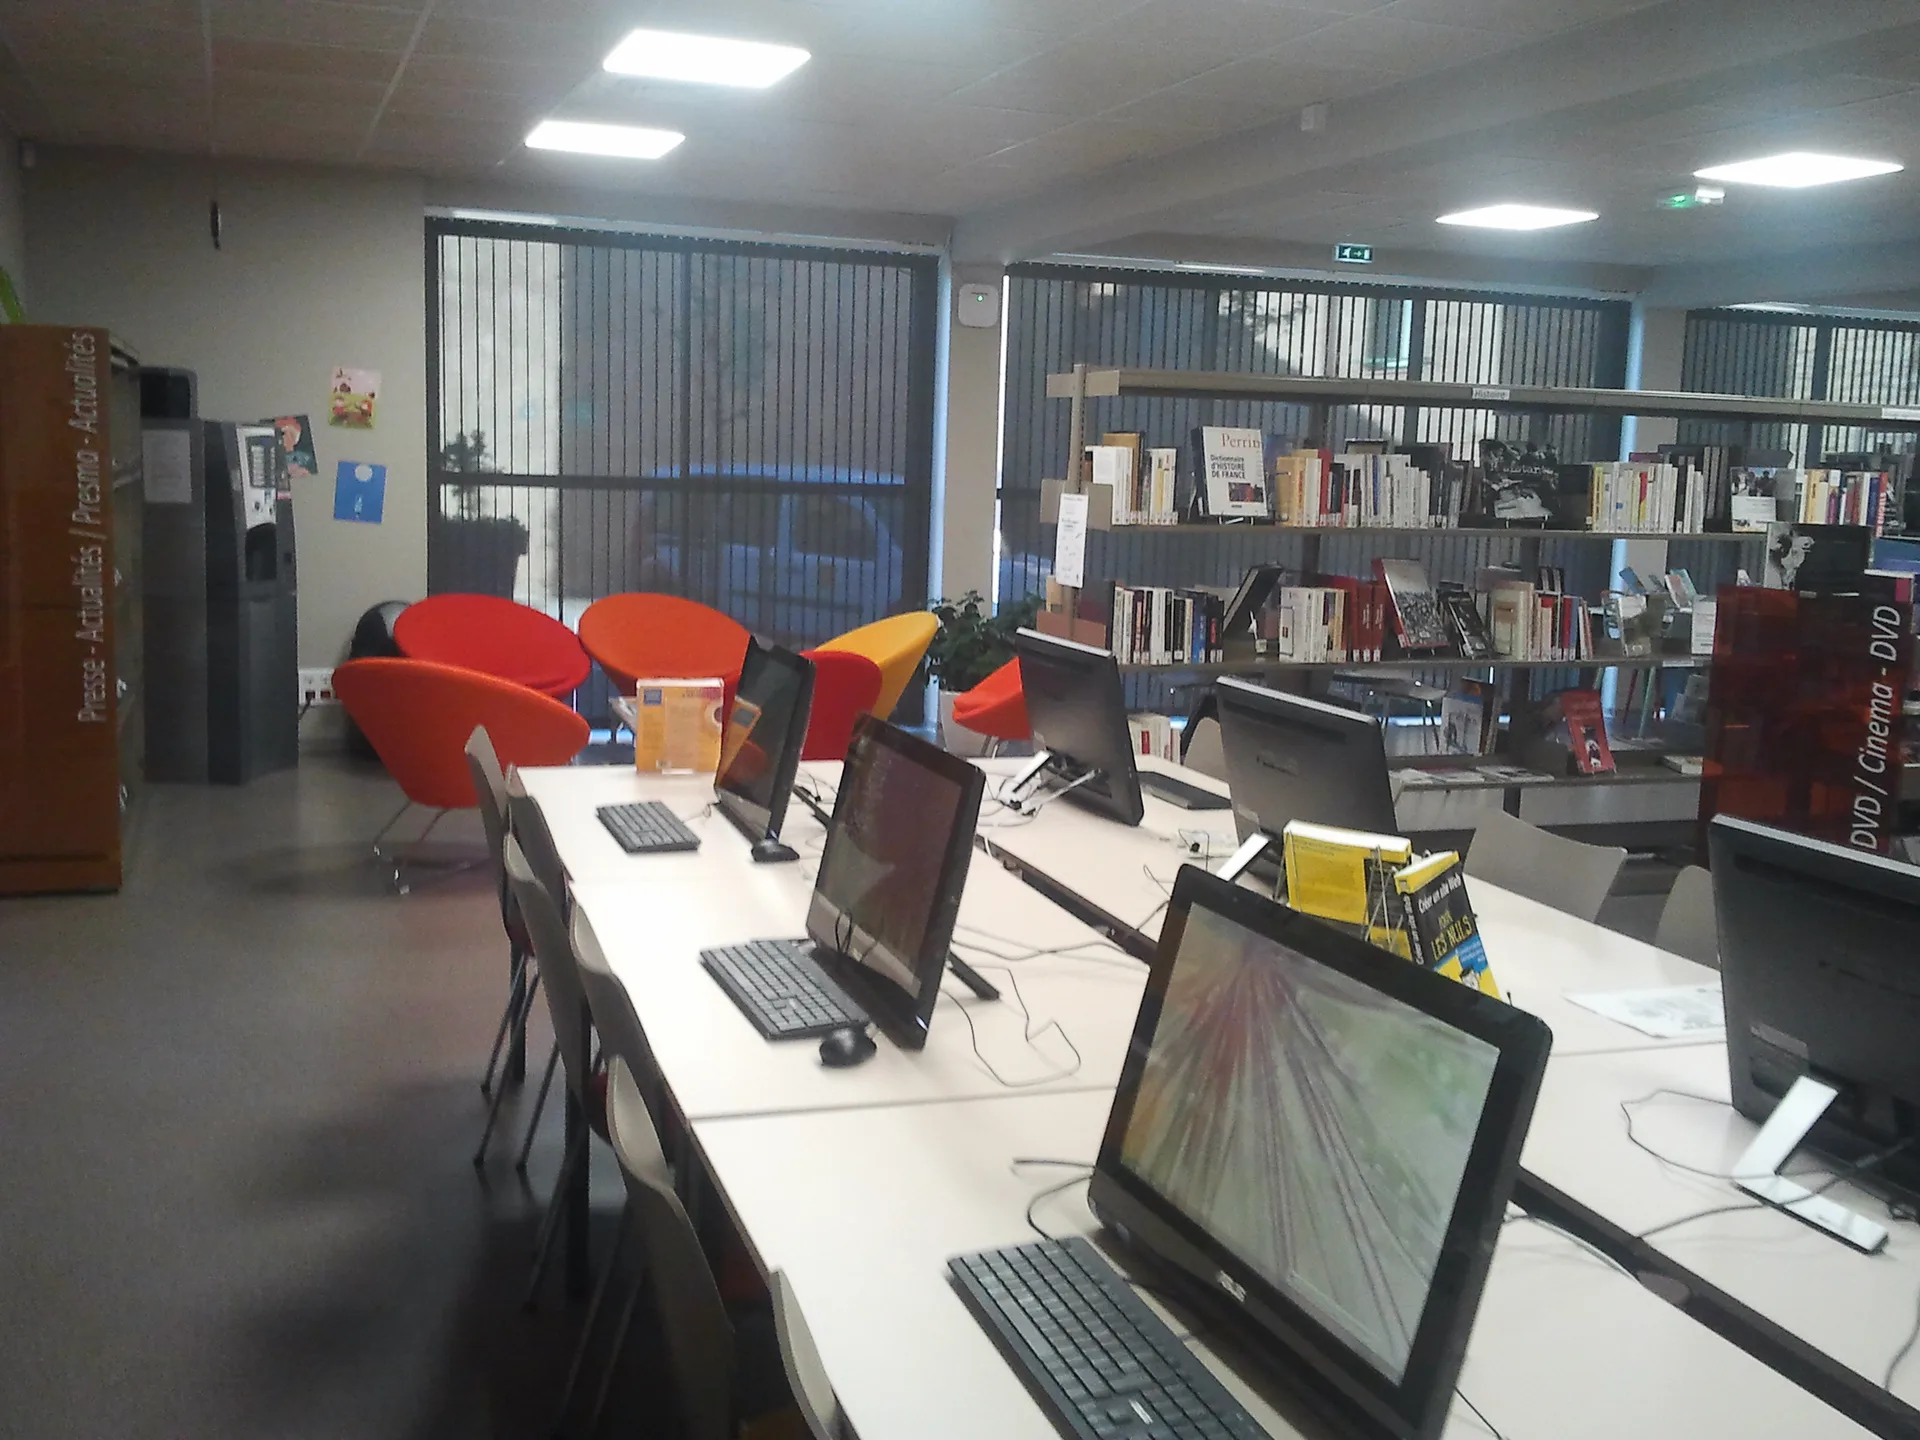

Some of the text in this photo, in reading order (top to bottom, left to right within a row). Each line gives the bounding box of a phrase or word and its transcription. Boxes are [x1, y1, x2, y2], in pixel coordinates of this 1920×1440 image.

[1222, 432, 1260, 448] Perrin
[1221, 471, 1246, 480] FRANCE
[67, 526, 108, 541] /
[71, 546, 104, 642] Actualités
[1869, 605, 1901, 662] DVD
[78, 659, 106, 722] Presse
[1858, 682, 1894, 774] Cinema
[1853, 775, 1888, 796] /
[1850, 795, 1881, 850] DVD
[1430, 931, 1448, 961] LES
[1446, 914, 1474, 948] NULS
